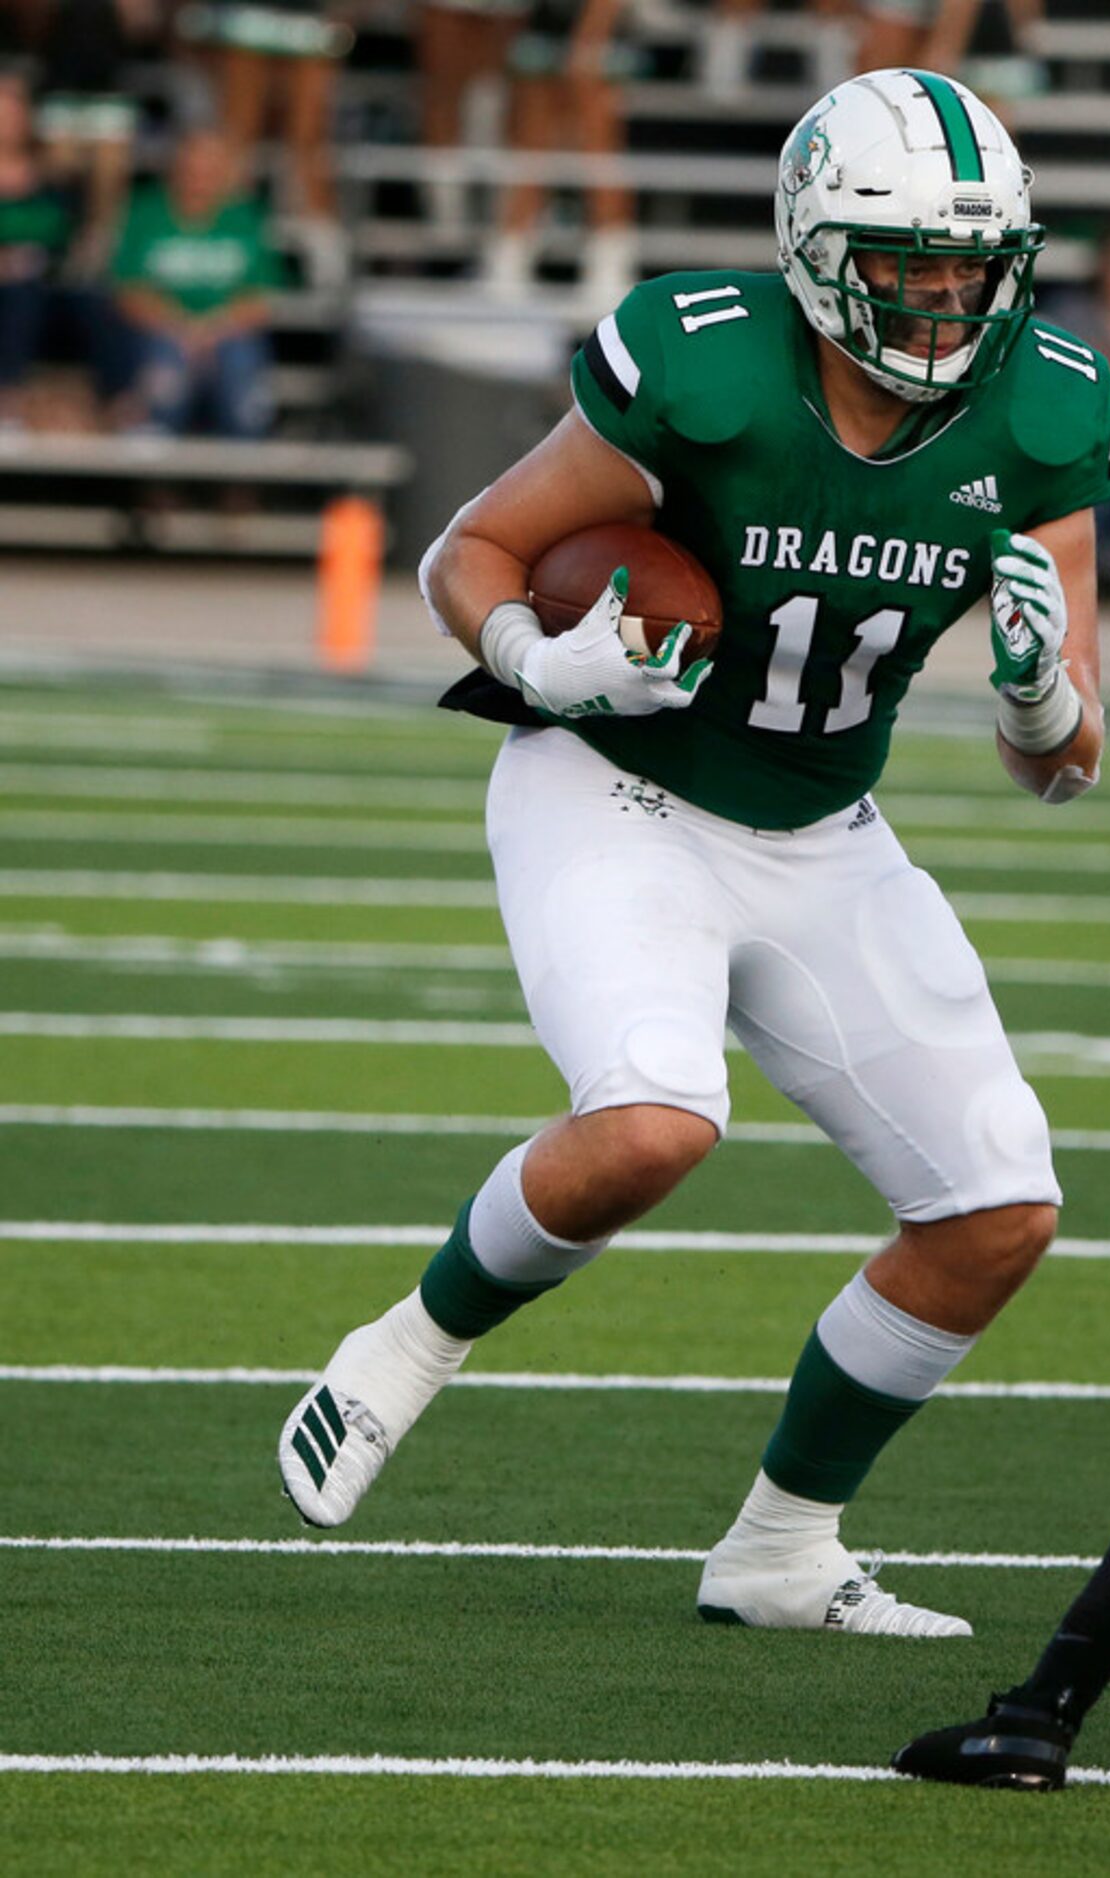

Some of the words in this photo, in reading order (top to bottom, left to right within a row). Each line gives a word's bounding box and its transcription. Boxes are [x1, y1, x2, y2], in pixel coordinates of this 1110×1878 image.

[673, 285, 750, 334] 11
[1033, 328, 1098, 382] 11
[949, 490, 1003, 514] adidas
[740, 526, 971, 590] DRAGONS
[747, 595, 906, 735] 11
